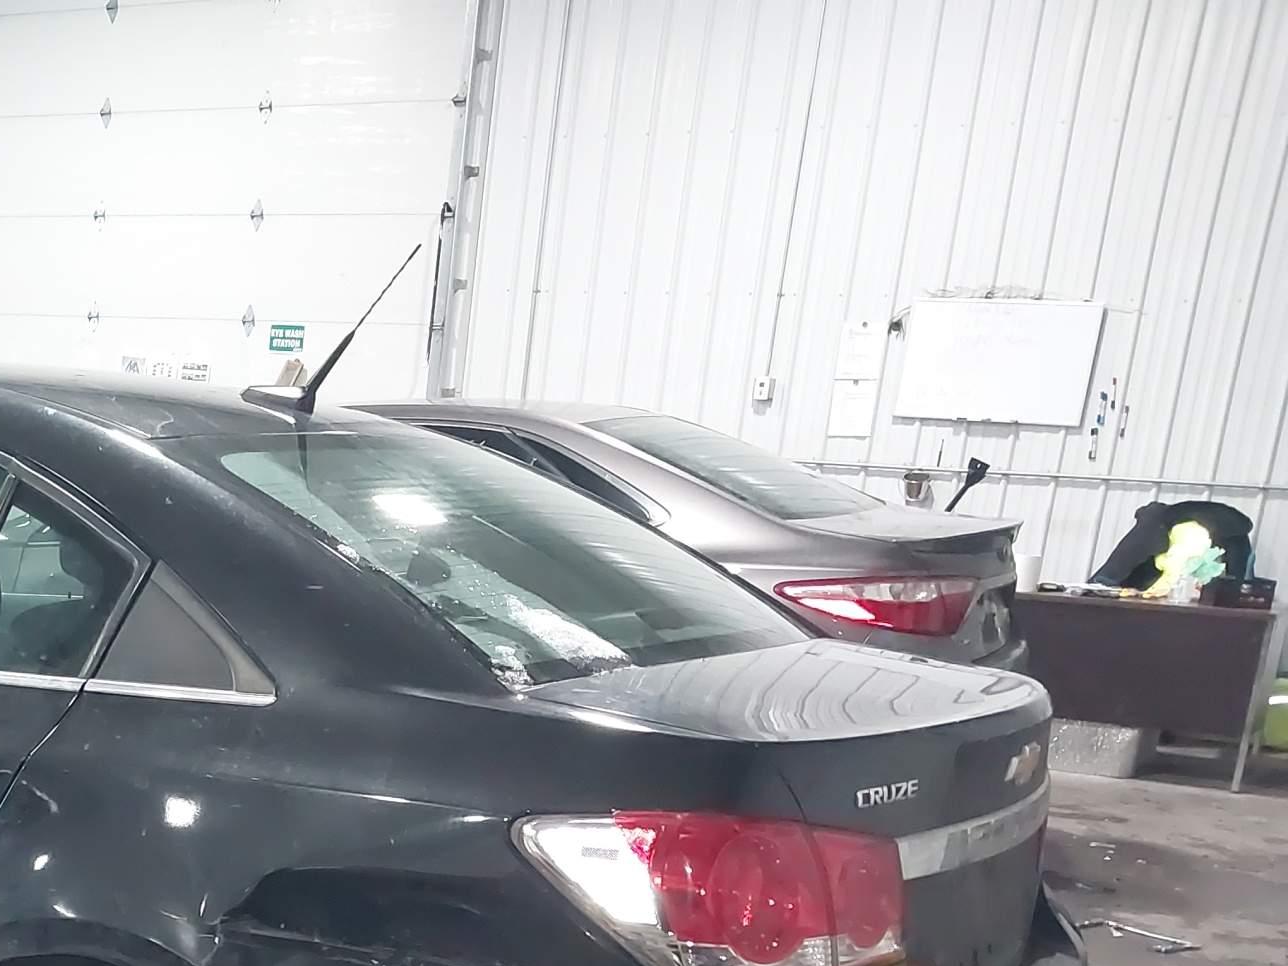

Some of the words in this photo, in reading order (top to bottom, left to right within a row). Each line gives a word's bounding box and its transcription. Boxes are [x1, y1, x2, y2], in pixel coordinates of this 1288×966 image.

[271, 328, 284, 338] EYE
[285, 329, 304, 339] WASH
[272, 338, 301, 348] STATION
[855, 779, 920, 809] CRUZE
